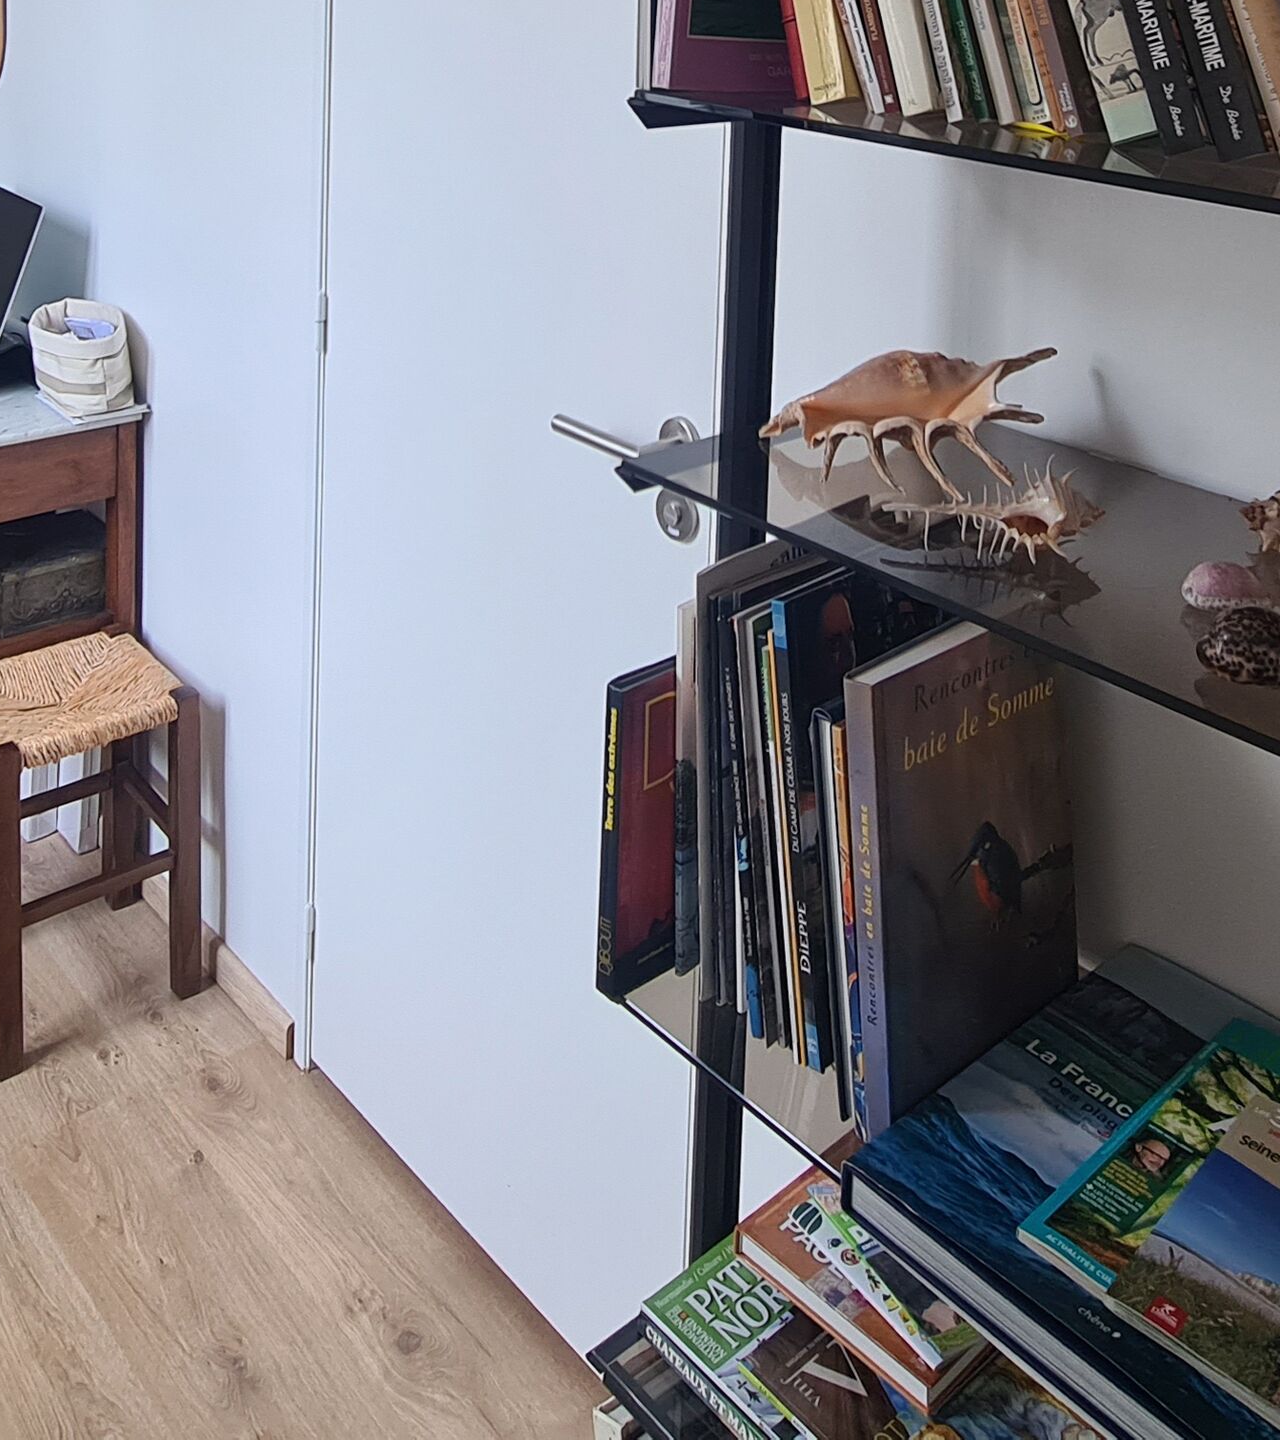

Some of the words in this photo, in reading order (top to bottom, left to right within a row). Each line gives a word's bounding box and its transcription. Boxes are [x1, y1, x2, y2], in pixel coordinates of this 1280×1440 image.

[954, 19, 975, 66] Bouchard
[967, 69, 984, 101] Pascal
[912, 645, 1016, 714] Rencontres
[778, 692, 791, 723] JOURS
[902, 732, 948, 772] baie
[954, 705, 980, 743] de
[985, 673, 1056, 725] Somme
[781, 723, 792, 744] NOS
[605, 770, 615, 795] des
[782, 755, 796, 787] CÉSAR
[603, 797, 615, 831] Terre
[787, 804, 799, 833] CAMP
[859, 804, 870, 861] Somme
[863, 886, 875, 919] baie
[790, 898, 815, 975] DIEPPE
[867, 944, 879, 1027] Rencontres
[1023, 1037, 1061, 1068] La
[1047, 1075, 1083, 1103] Des
[1045, 1233, 1096, 1273] ACTUALITÉS
[1077, 1304, 1113, 1336] chêne
[644, 1326, 708, 1400] CHATEAUX
